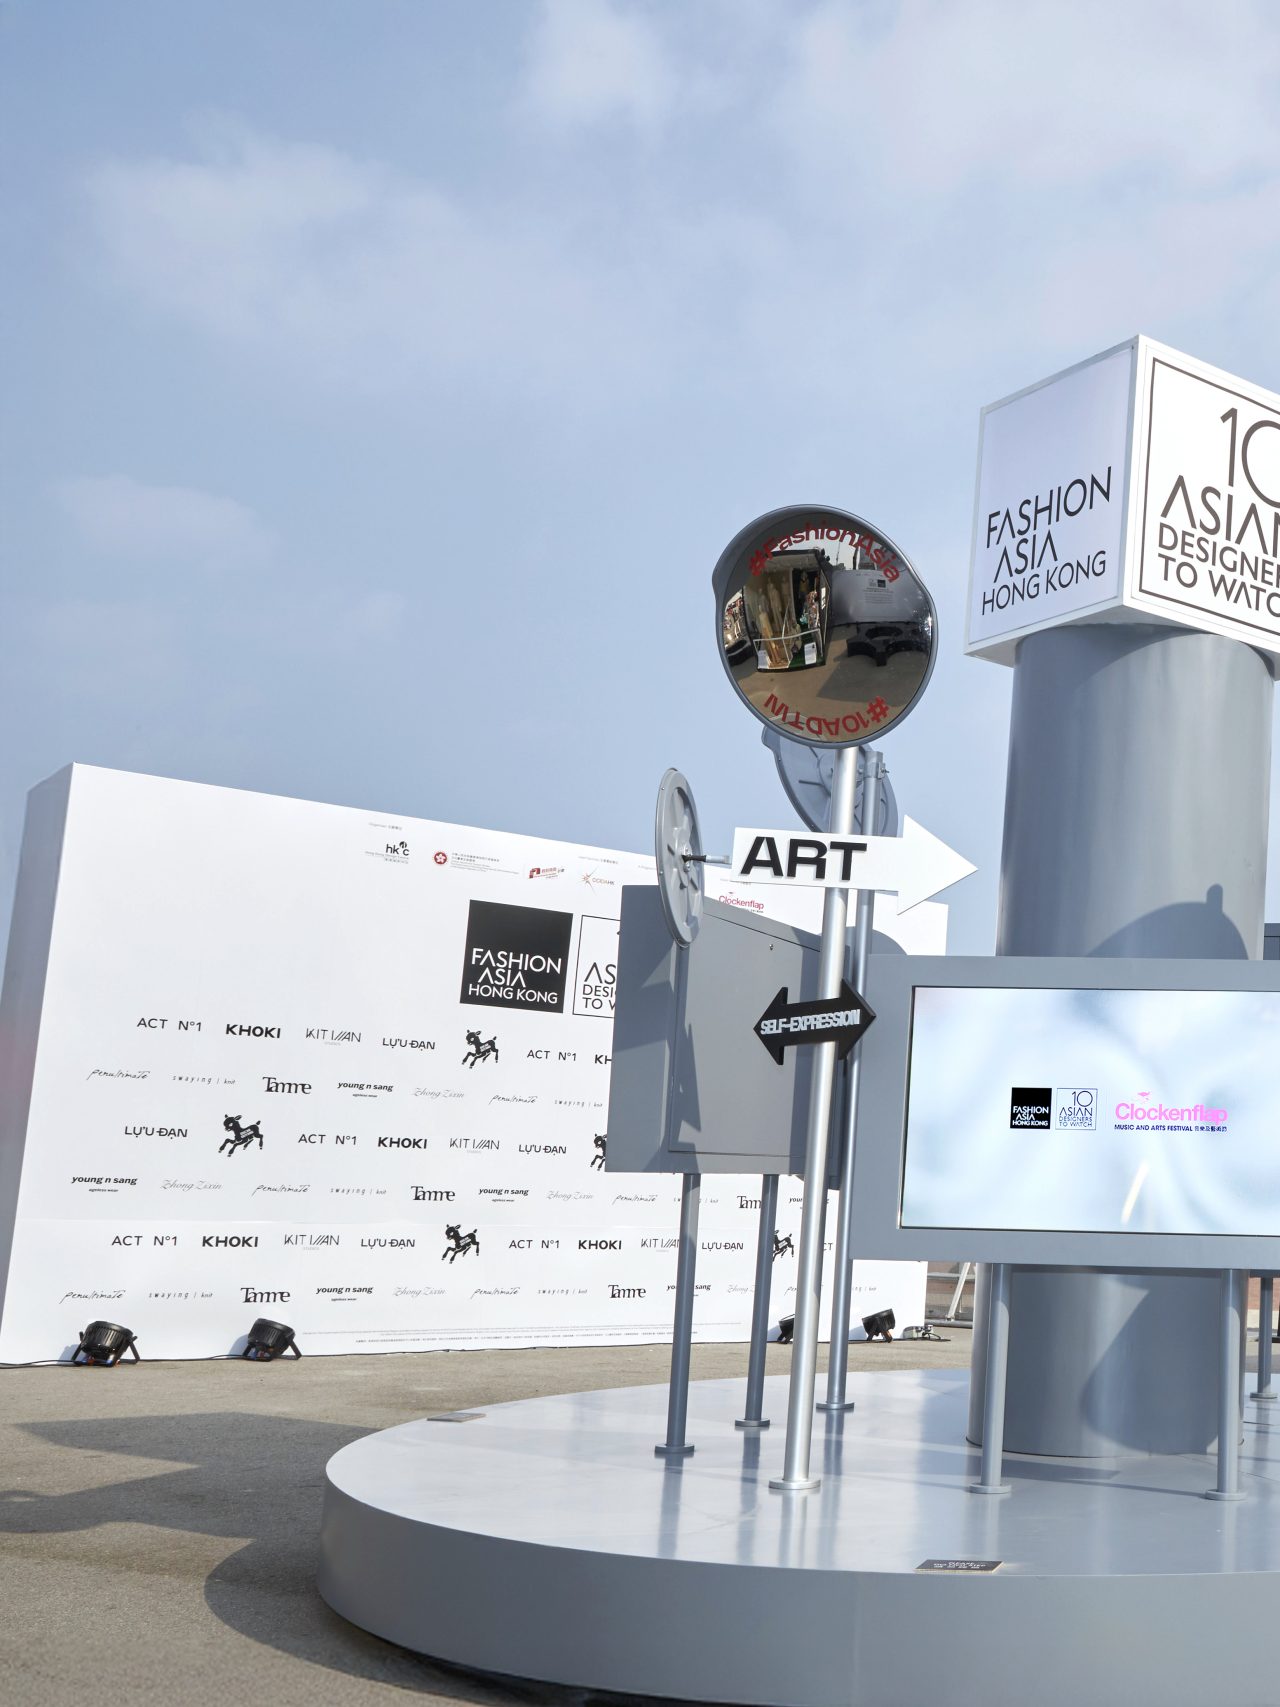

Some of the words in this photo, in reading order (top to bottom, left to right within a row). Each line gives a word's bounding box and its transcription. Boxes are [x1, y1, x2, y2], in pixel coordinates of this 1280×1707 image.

[986, 466, 1111, 548] FASHION
[750, 520, 900, 583] #FashionAsia
[994, 530, 1058, 583] ASIA
[1158, 553, 1198, 588] TO
[982, 576, 1040, 616] HONG
[1045, 550, 1106, 594] KONG
[740, 836, 867, 881] ART
[719, 895, 764, 910] Clockenflap
[472, 948, 562, 974] FASHION
[478, 967, 526, 987] ASIA
[468, 984, 513, 1000] HONG
[516, 989, 558, 1004] KONG
[583, 997, 602, 1010] TO
[137, 1018, 168, 1029] ACT
[761, 1009, 860, 1035] SELF-EXPRESSION
[225, 1024, 281, 1039] KHOKI
[306, 1028, 328, 1040] KIT
[527, 1050, 550, 1059] ACT
[172, 1075, 212, 1085] swaying
[337, 1081, 365, 1091] young
[373, 1084, 394, 1092] sang
[1072, 1090, 1093, 1107] 10
[1012, 1106, 1049, 1114] FASHION
[1060, 1107, 1092, 1116] ASIAN
[1115, 1103, 1228, 1125] Clockenflap
[1016, 1113, 1036, 1121] ASIA
[298, 1134, 326, 1144] ACT
[377, 1136, 428, 1149] KHOKI
[449, 1138, 470, 1149] KIT
[71, 1176, 103, 1186] young
[113, 1177, 138, 1186] sang
[478, 1188, 503, 1196] young
[510, 1189, 530, 1197] sang
[111, 1236, 143, 1246] ACT
[202, 1236, 259, 1248] KHOKI
[284, 1234, 307, 1246] KIT
[508, 1240, 533, 1249] ACT
[578, 1240, 622, 1250] KHOKI
[640, 1239, 659, 1248] KIT
[352, 1286, 373, 1294] sang
